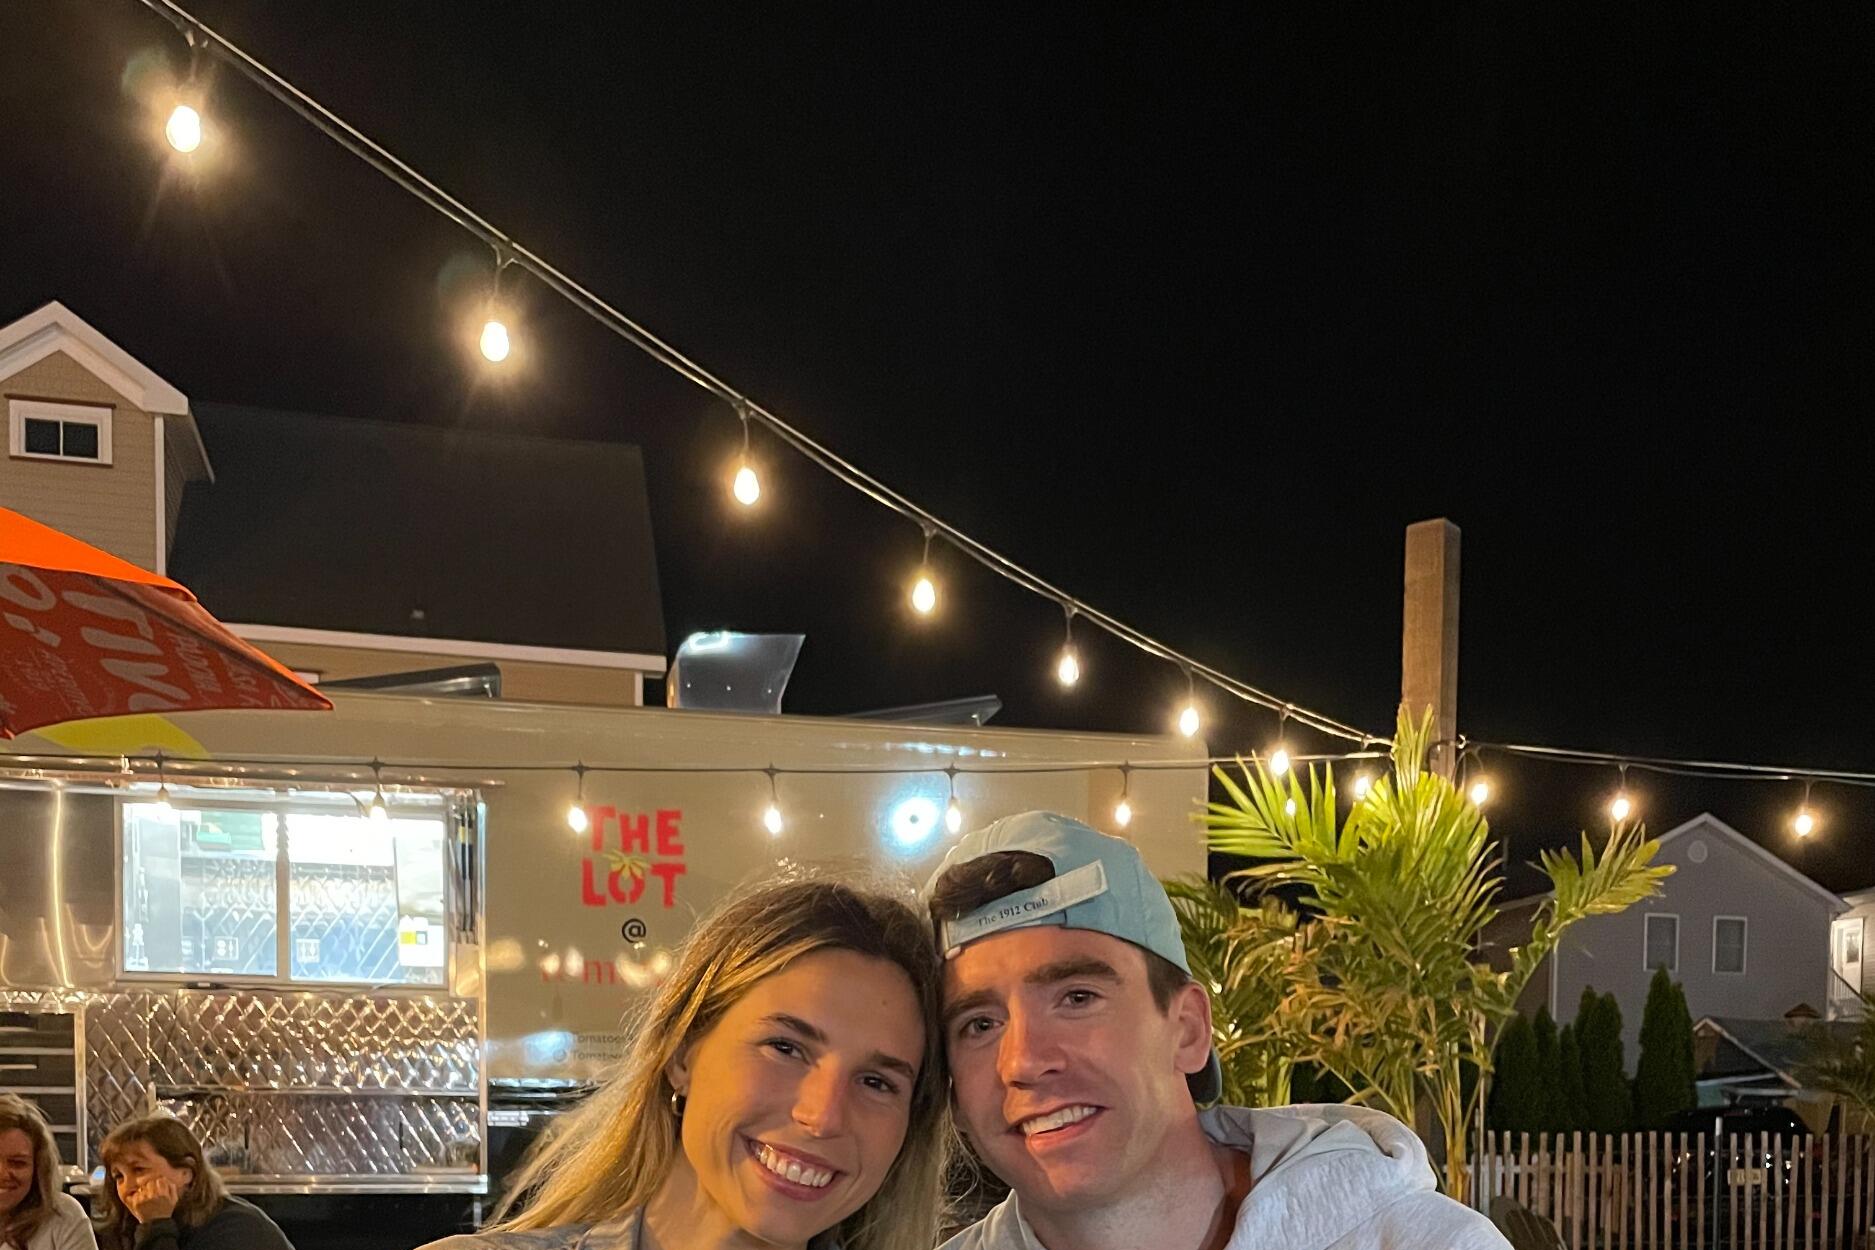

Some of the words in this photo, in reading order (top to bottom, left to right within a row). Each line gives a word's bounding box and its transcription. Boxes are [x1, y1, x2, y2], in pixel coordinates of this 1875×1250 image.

[587, 804, 685, 857] THE
[581, 857, 688, 909] LOT
[621, 918, 647, 943] @
[977, 915, 997, 926] The
[999, 905, 1021, 919] 1912
[1023, 897, 1049, 912] Club
